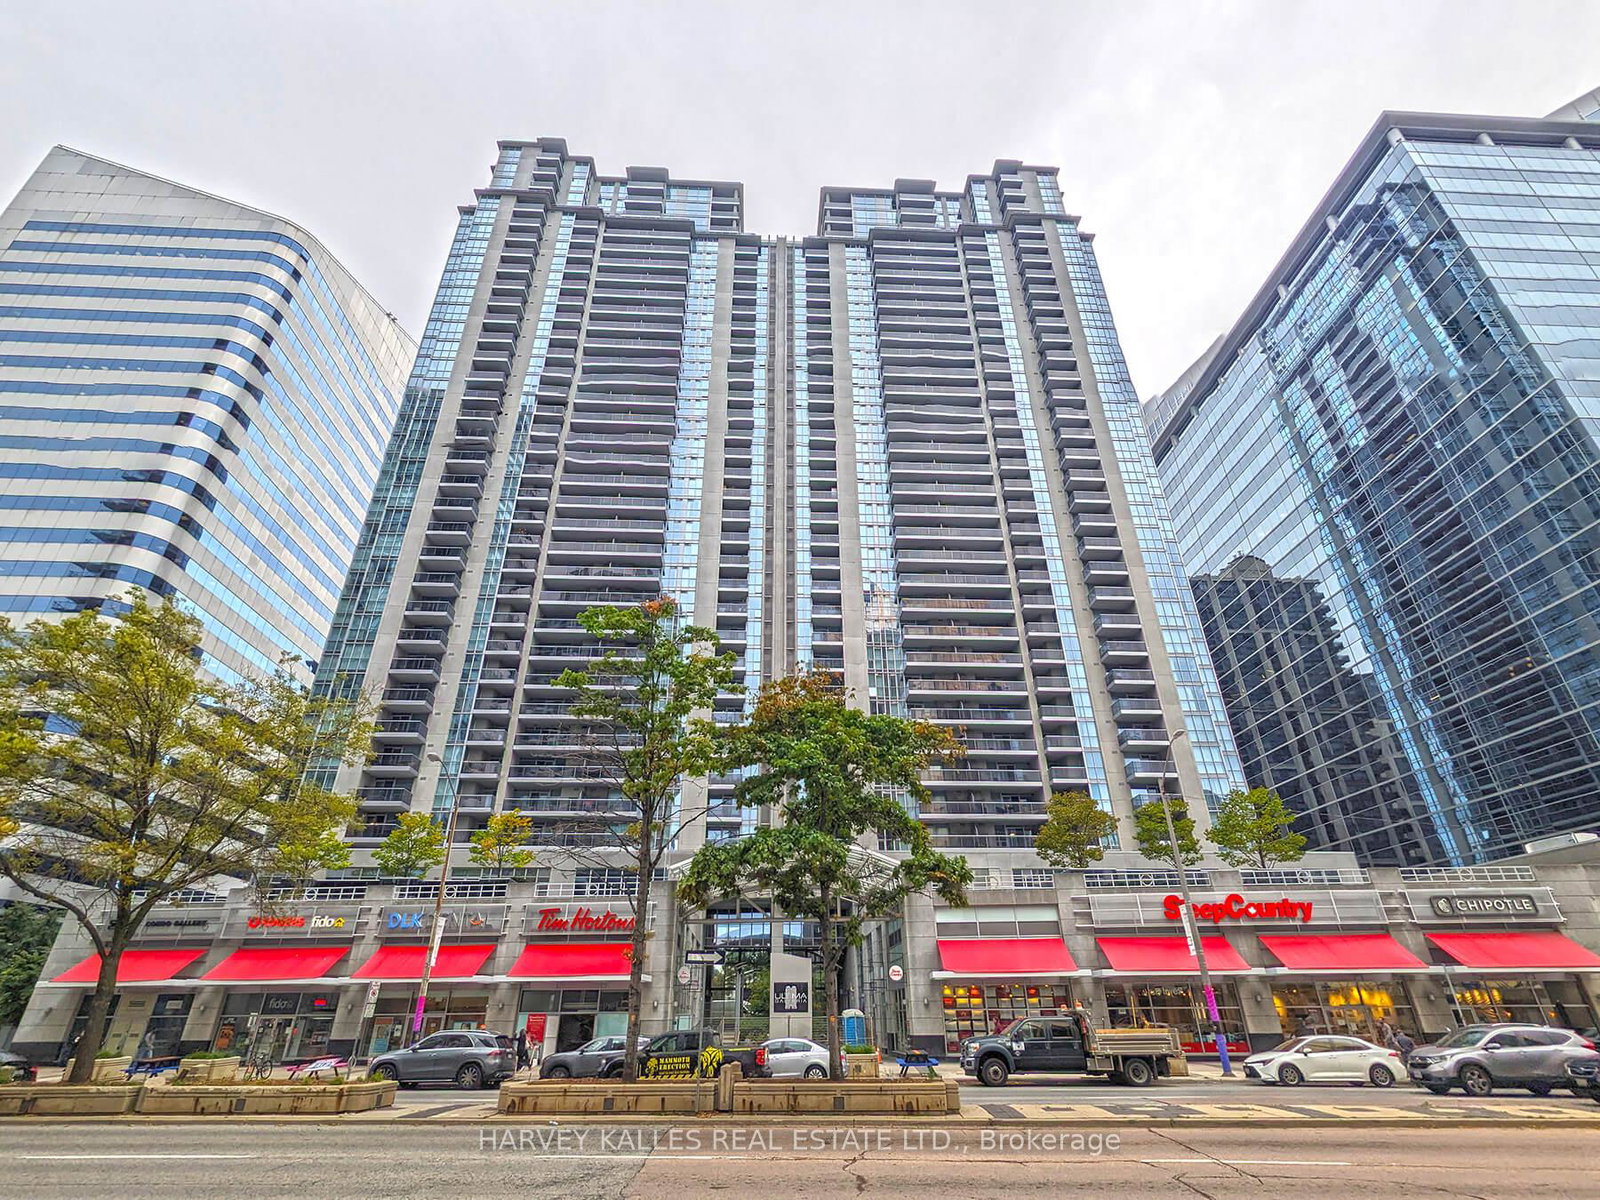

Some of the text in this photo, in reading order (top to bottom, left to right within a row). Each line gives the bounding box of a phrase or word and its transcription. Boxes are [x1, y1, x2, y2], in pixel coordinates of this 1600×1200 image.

[1163, 894, 1313, 923] SeepCountry
[1456, 899, 1533, 911] CHIPOTLE
[310, 915, 335, 928] fido
[387, 912, 425, 930] DLK
[537, 908, 571, 931] Tim
[659, 1056, 691, 1064] MAMMOTH
